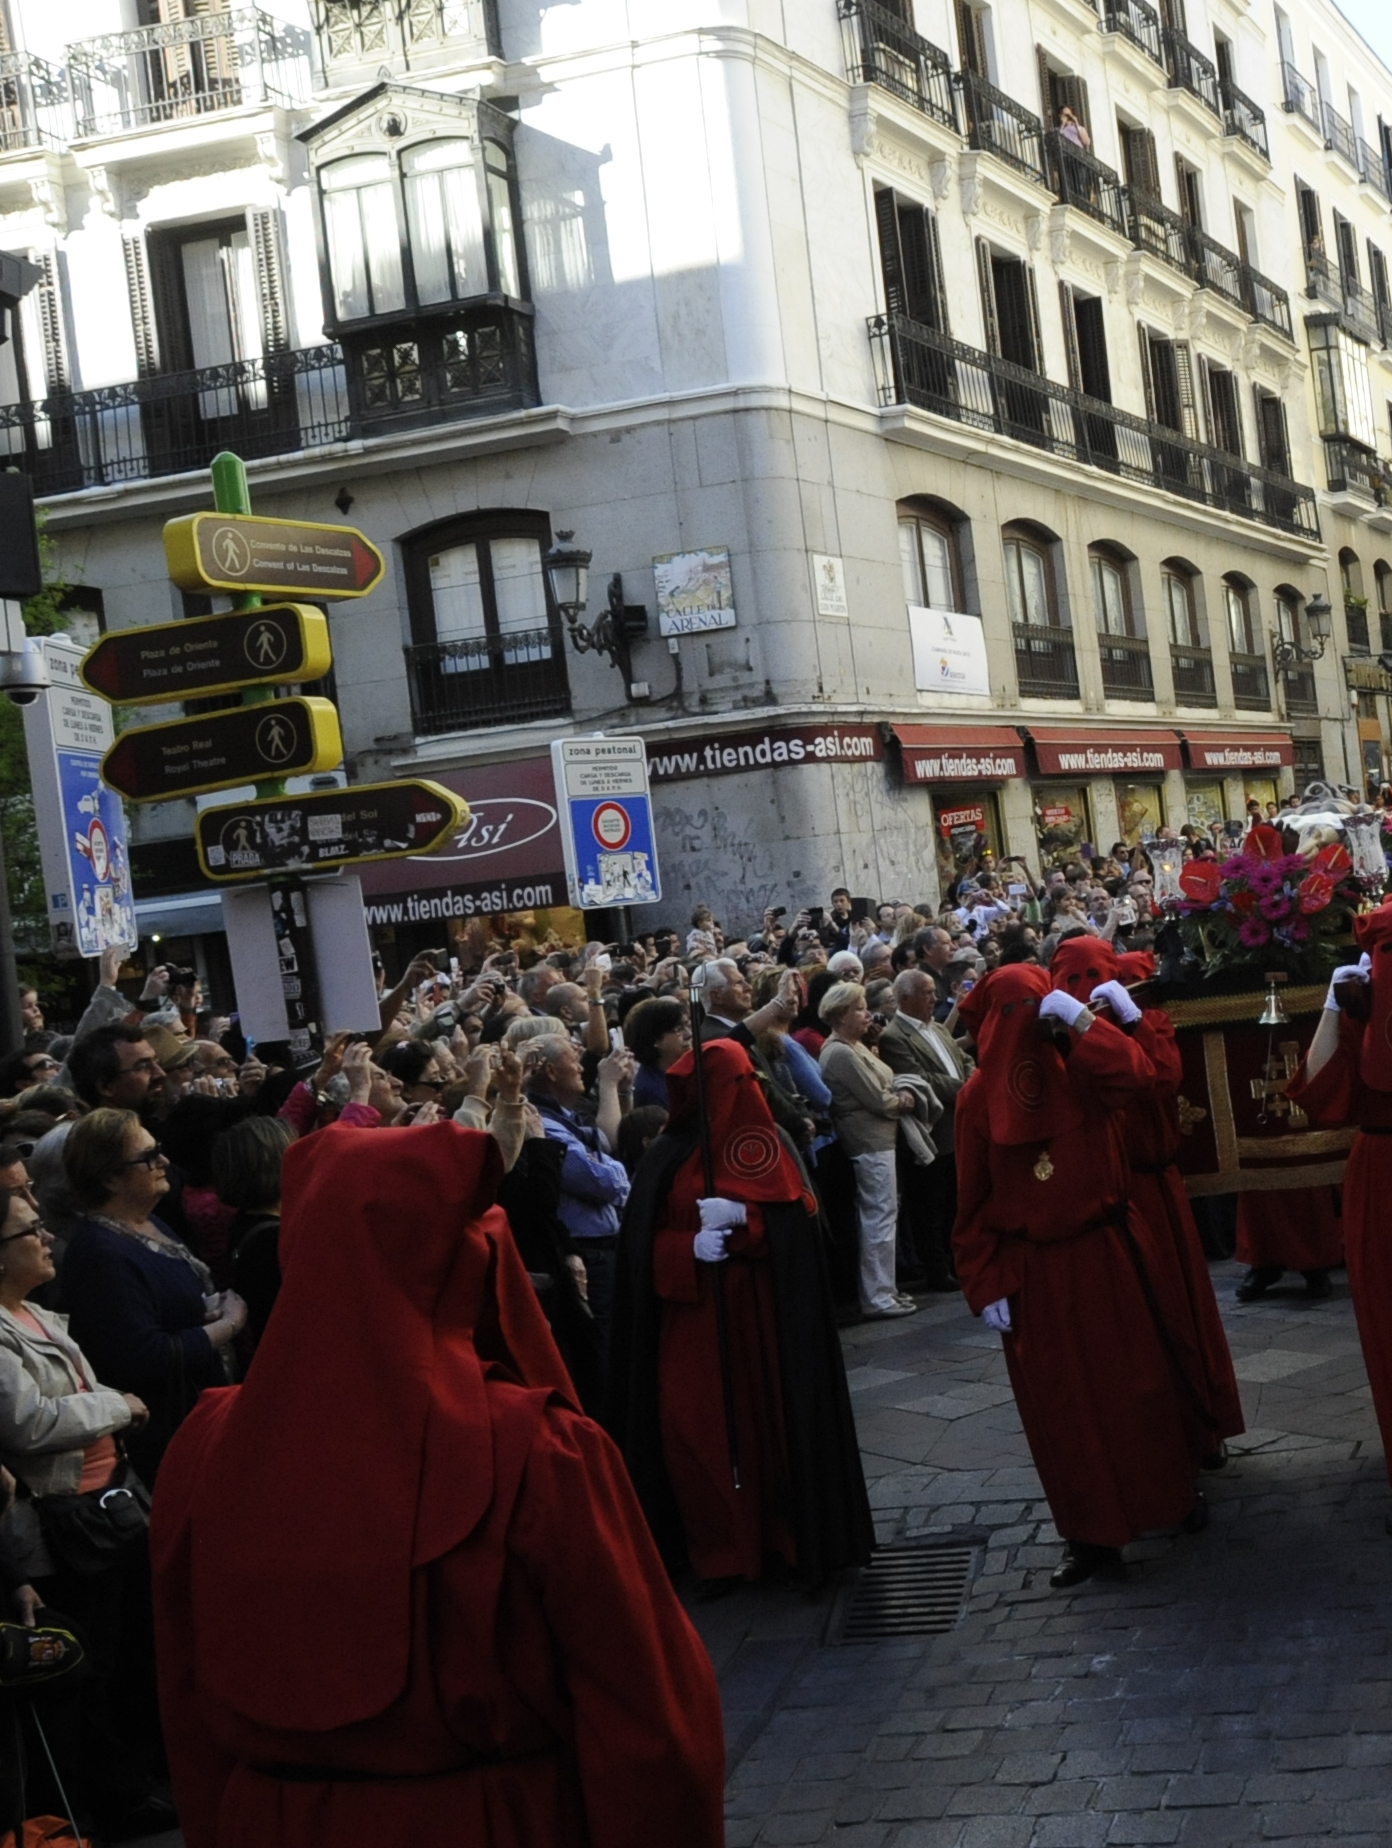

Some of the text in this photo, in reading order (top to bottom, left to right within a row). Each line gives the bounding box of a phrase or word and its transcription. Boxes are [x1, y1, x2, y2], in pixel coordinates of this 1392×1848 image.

[251, 540, 351, 557] Convento de Las Descalzas
[253, 559, 348, 575] Convent of Las Descalzas
[667, 605, 706, 619] CALLE
[667, 612, 729, 634] ARENAL
[141, 640, 218, 660] Plaza de Oriente
[49, 657, 68, 674] zona
[143, 658, 220, 678] Plaza de Oriente
[162, 739, 212, 756] Teatro Real
[568, 744, 637, 757] zona peatonal
[915, 752, 1017, 778] www.tiendas-asi.com
[1058, 748, 1164, 769] www.tiendas-asi.com
[1204, 747, 1281, 766] www.tiendas-asi.com
[165, 756, 226, 775] Royal Theatre
[592, 765, 618, 773] PERMITIDO
[612, 777, 633, 785] VIERNES
[360, 809, 378, 822] Sol
[940, 808, 983, 827] OFERTAS
[232, 850, 261, 866] PRADA
